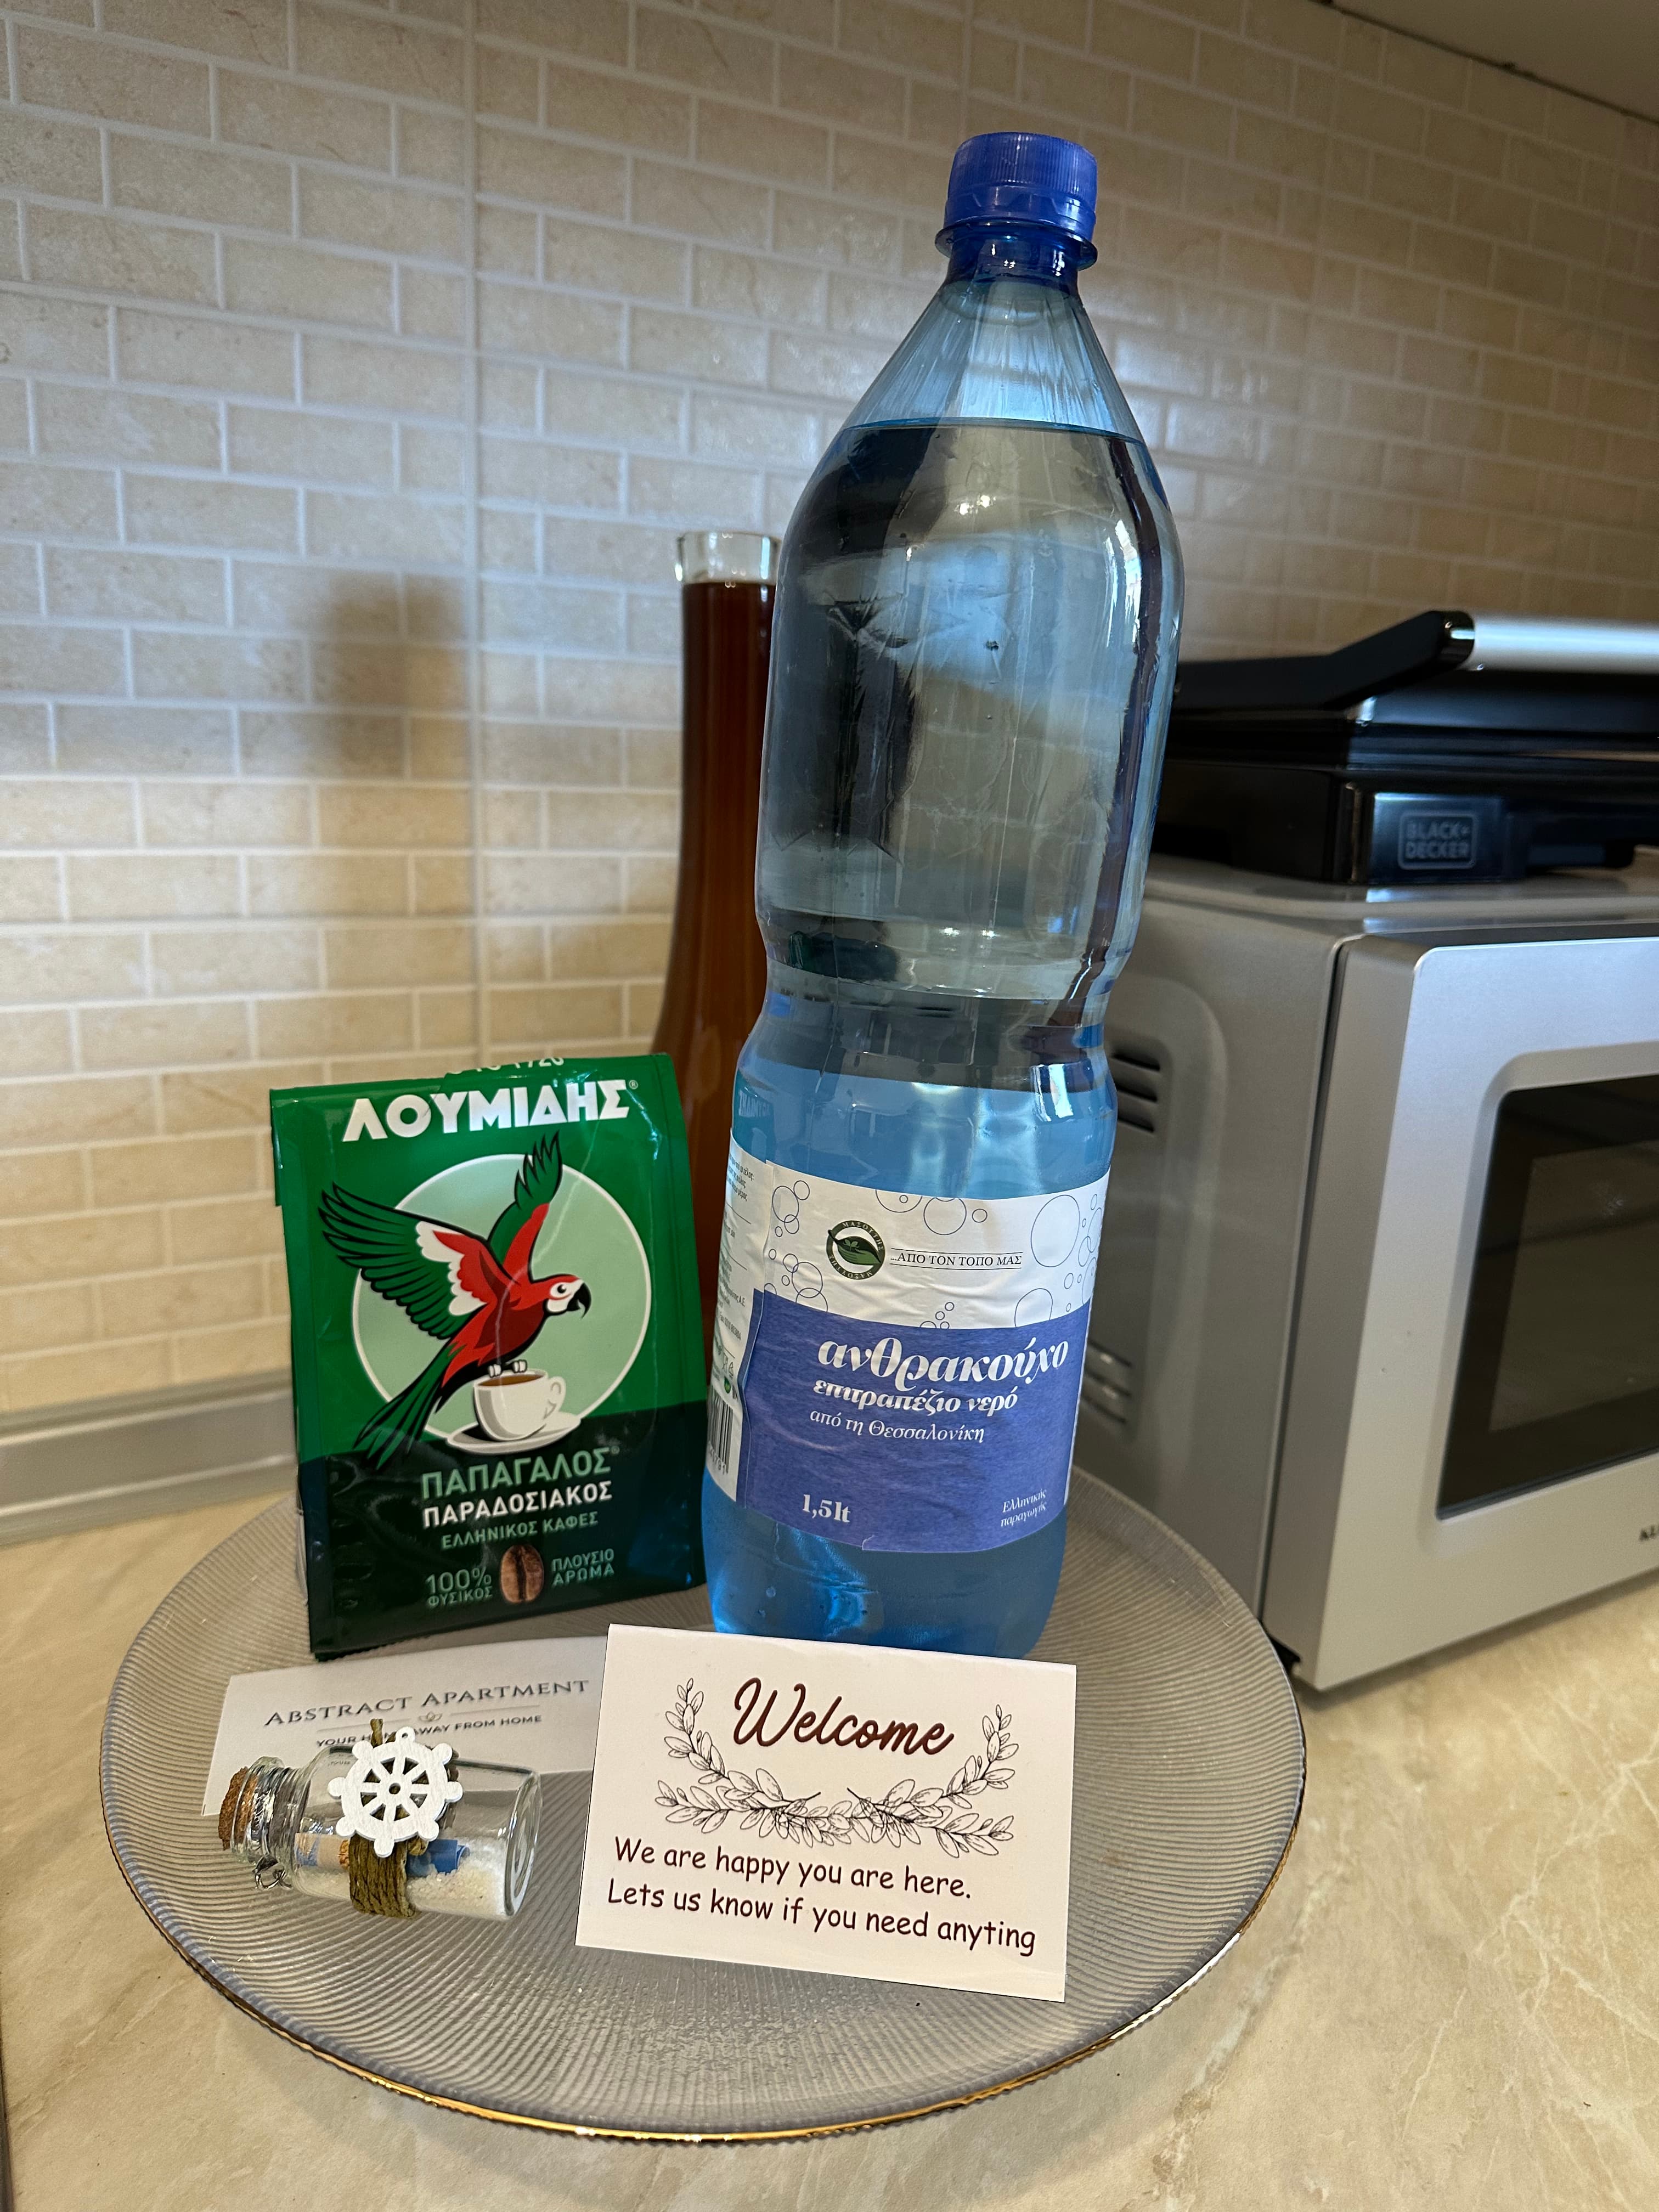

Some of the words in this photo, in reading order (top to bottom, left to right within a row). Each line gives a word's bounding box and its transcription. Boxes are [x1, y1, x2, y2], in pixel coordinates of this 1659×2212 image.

[929, 1255, 956, 1265] ΤΟΝ
[958, 1255, 994, 1266] ΤΟΠΟ
[996, 1255, 1022, 1265] ΜΑΣ
[817, 1337, 1070, 1392] ανθρακούχο
[813, 1379, 961, 1416] επιτραπέζιο
[966, 1386, 1018, 1417] νερό
[810, 1409, 841, 1430] από
[845, 1417, 863, 1436] τη
[868, 1420, 985, 1443] Θεσσαλονίκη
[424, 1481, 613, 1528] ΠΑΡΑΔΟΣΙΑΚΟΣ
[1000, 1502, 1047, 1527] παραγωγής
[1002, 1489, 1047, 1513] Ελληνικής
[442, 1521, 538, 1550] ΕΛΛΗΝΙΚΟΣ
[543, 1511, 599, 1534] ΚΑΦΕΣ
[551, 1548, 615, 1573] ΠΛΟΥΣΙΟ
[552, 1564, 614, 1587] ΑΡΩΜΑ
[425, 1567, 492, 1594] 100%
[427, 1586, 493, 1607] ΦΥΣΙΚΟΣ
[264, 1696, 412, 1726] ABSTRACT
[421, 1679, 590, 1707] APARTMENT
[733, 1677, 954, 1756] Welcome
[317, 1735, 357, 1747] YOUR
[454, 1719, 496, 1730] FROM
[500, 1714, 542, 1725] HOME
[614, 1837, 655, 1864] We
[664, 1849, 706, 1869] are
[716, 1846, 790, 1885] happy
[798, 1862, 842, 1886] you
[850, 1870, 894, 1890] are
[904, 1865, 972, 1900] here.
[608, 1879, 663, 1908] Lets
[674, 1892, 701, 1912] us
[710, 1887, 774, 1919] know
[783, 1897, 804, 1923] if
[812, 1907, 856, 1933] you
[866, 1908, 928, 1938] need
[937, 1918, 1036, 1957] anyting
